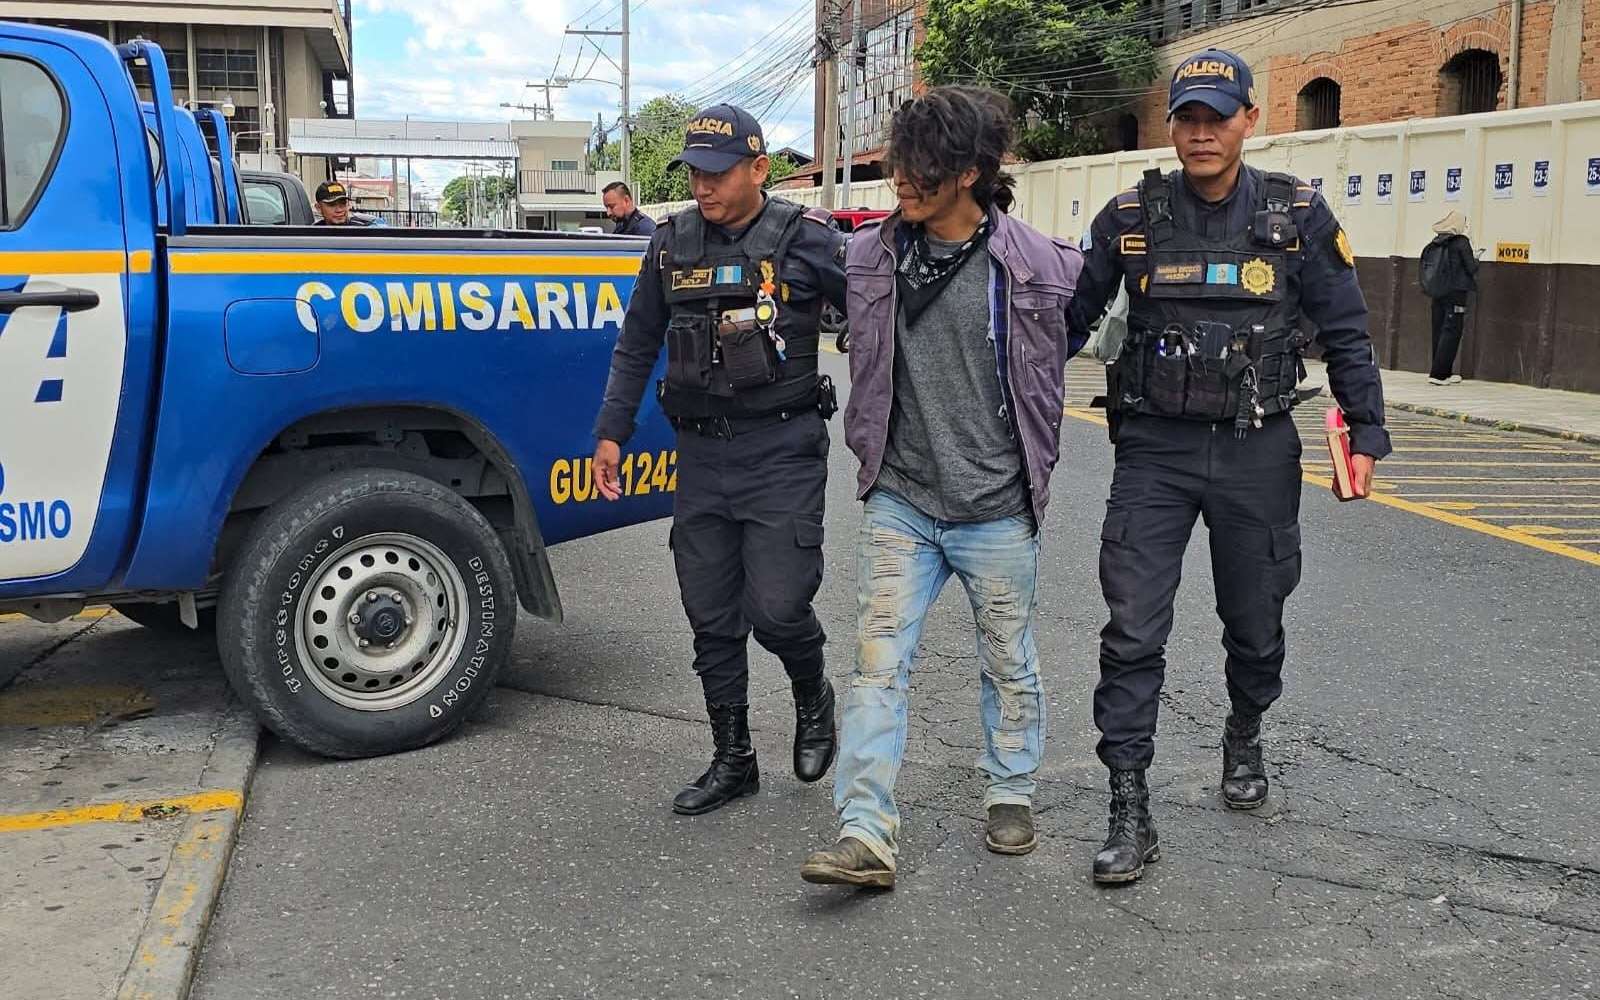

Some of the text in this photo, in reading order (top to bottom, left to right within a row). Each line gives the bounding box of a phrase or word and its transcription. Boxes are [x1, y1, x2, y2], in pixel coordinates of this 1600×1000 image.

[1175, 60, 1234, 83] POLICIA
[1495, 171, 1512, 185] 21-22
[1498, 247, 1529, 259] MOTOS
[295, 280, 627, 334] COMISARIA
[442, 556, 495, 707] DESTINATION
